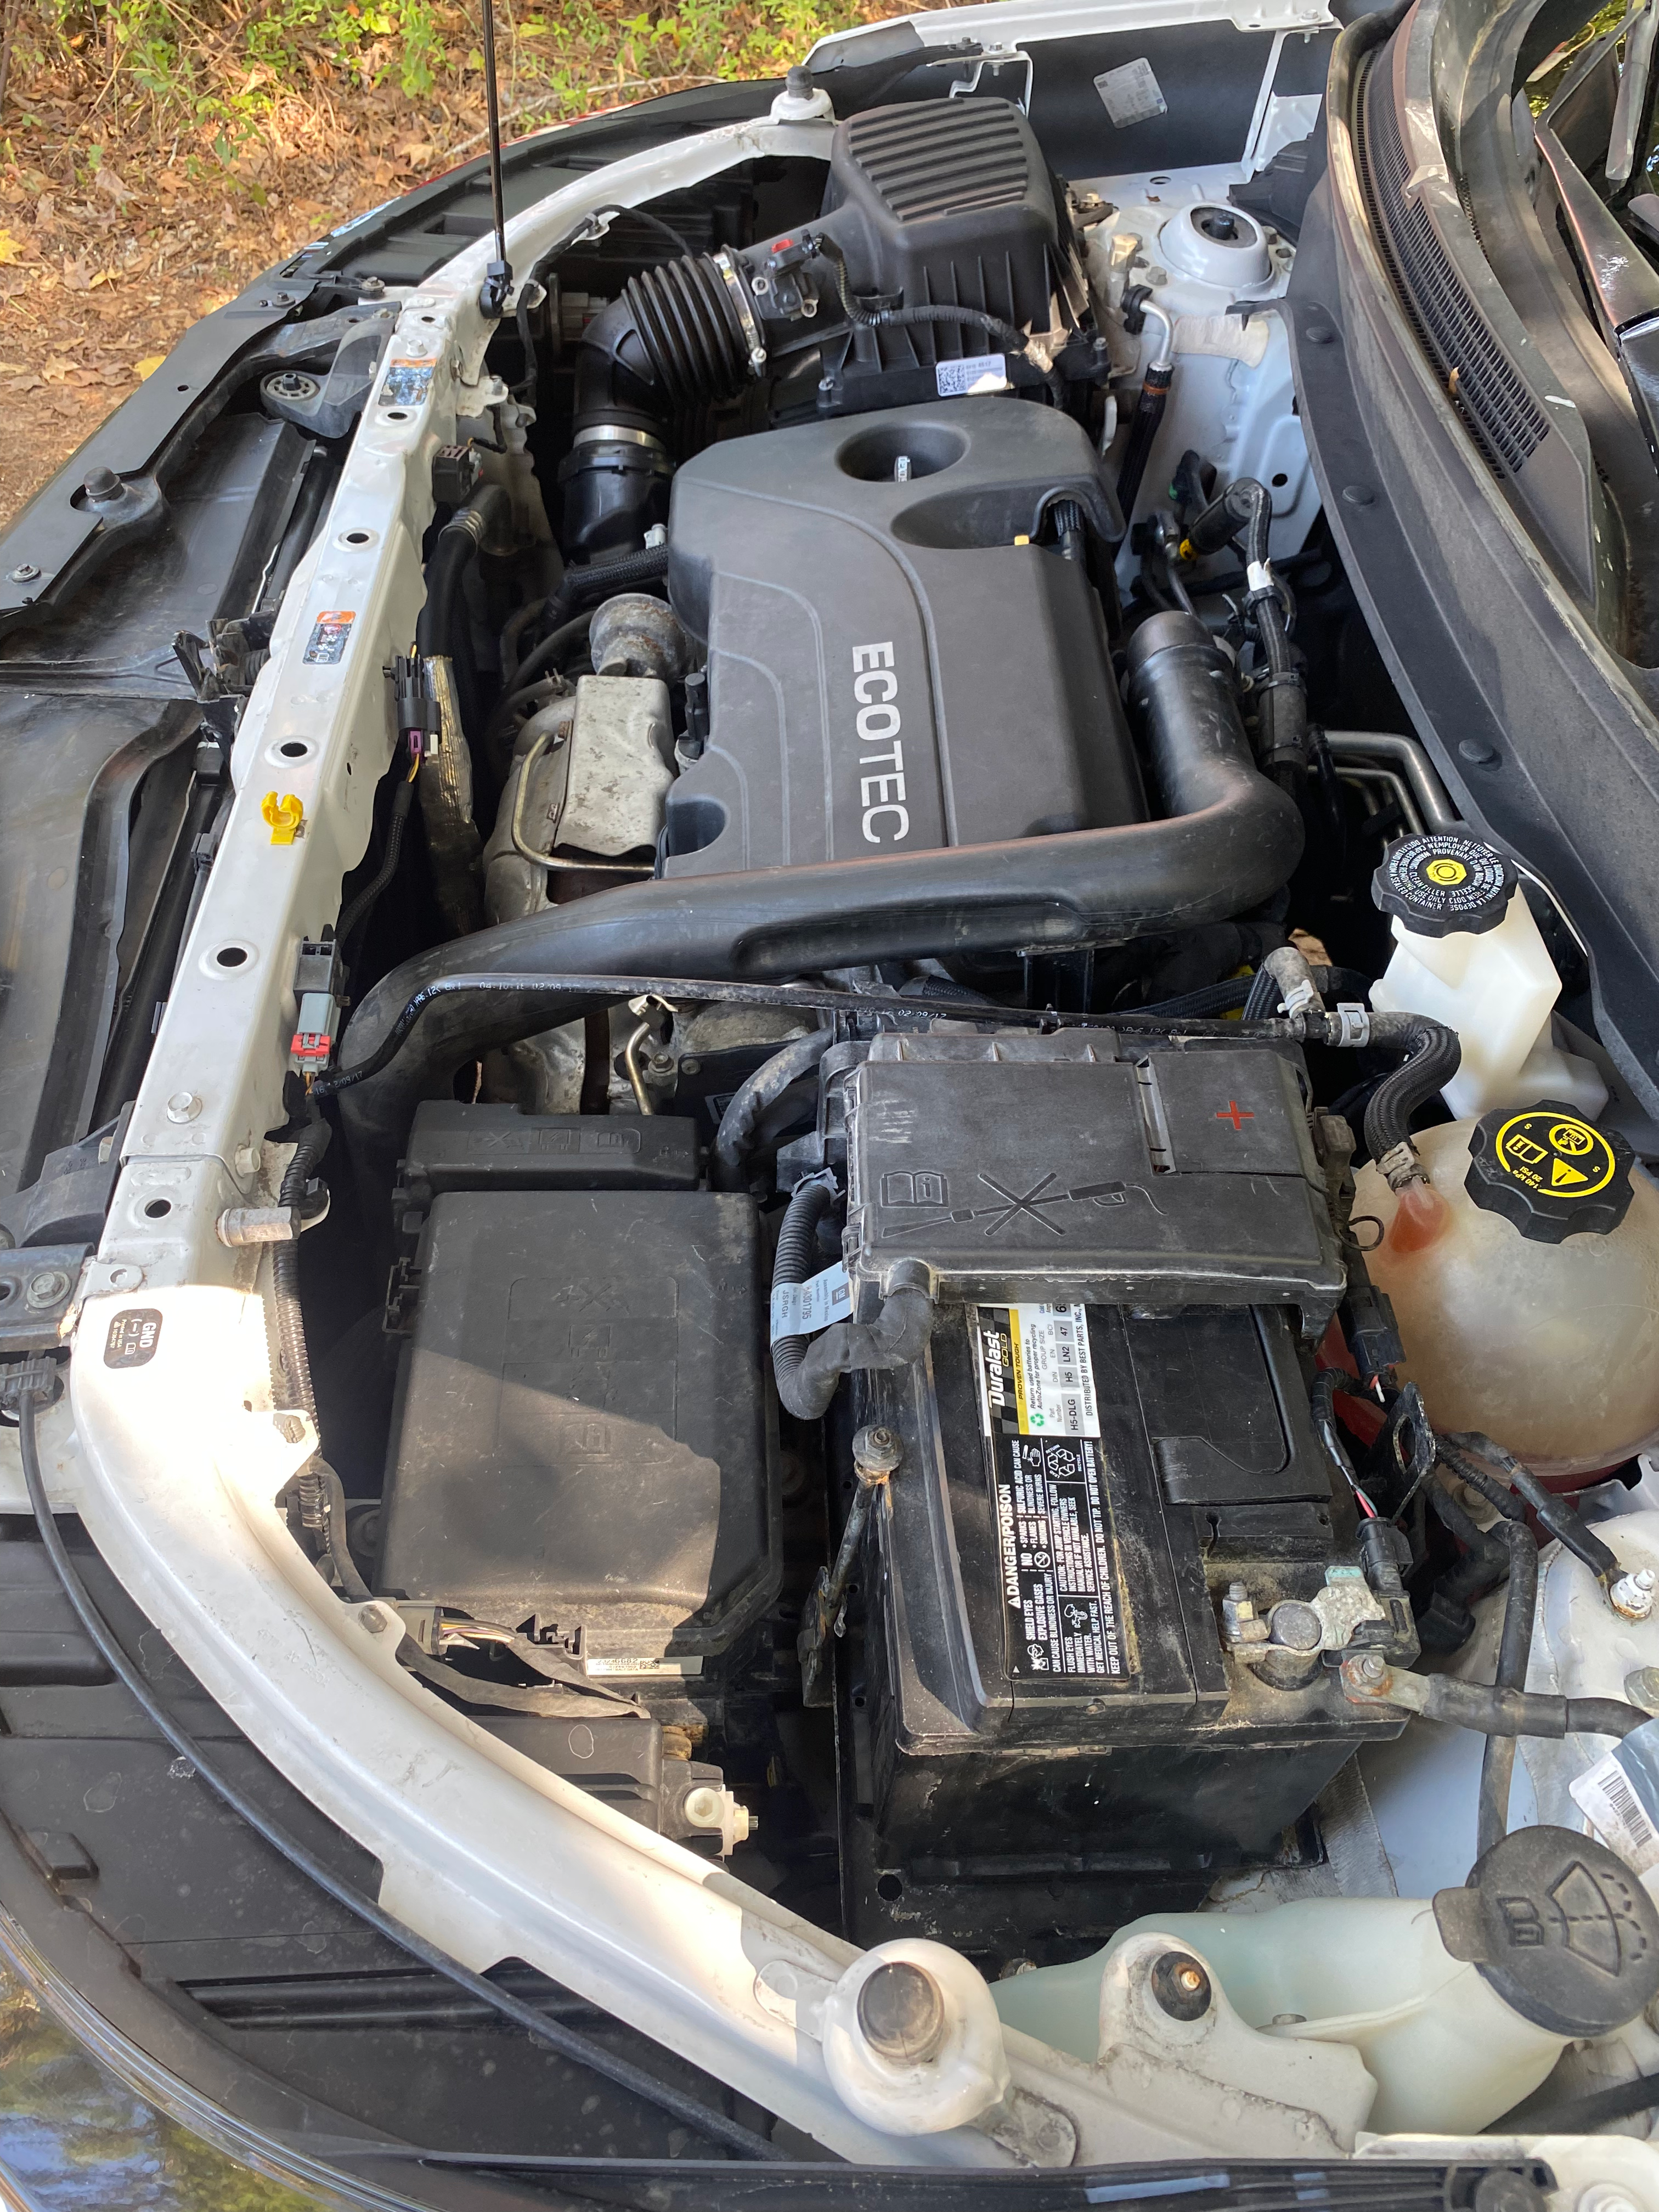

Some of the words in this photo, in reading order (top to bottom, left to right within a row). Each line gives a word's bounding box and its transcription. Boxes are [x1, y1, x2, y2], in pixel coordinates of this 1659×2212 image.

[853, 641, 909, 843] ECOTEC
[1393, 848, 1408, 860] FLUID
[1415, 845, 1426, 854] CAP
[1432, 849, 1473, 861] PROVENANT
[1463, 839, 1493, 858] NETTOYER
[1389, 860, 1399, 872] FROM
[1400, 850, 1417, 867] BEFORE
[1427, 842, 1469, 852] N'EMPLOYER
[1469, 850, 1482, 859] QUE
[1483, 866, 1493, 883] LIQUIDE
[1399, 867, 1416, 890] REMOVING
[1409, 872, 1423, 887] CLEAN
[1421, 885, 1445, 896] FILLER
[1493, 864, 1504, 887] BOUCHON
[1391, 877, 1408, 894] SEALED
[1452, 885, 1475, 897] SCELLE
[1485, 886, 1500, 900] AVANT
[1405, 893, 1442, 910] CONTAINER
[1414, 890, 1428, 899] USE
[1428, 895, 1446, 903] ONLY
[1450, 902, 1477, 911] DEPOSE
[1513, 1169, 1527, 1181] kPa
[1519, 1166, 1533, 1176] PSI
[1531, 1174, 1543, 1182] 20
[1525, 1178, 1538, 1189] 140
[838, 1289, 845, 1299] GM
[139, 1323, 156, 1347] GND
[1060, 1327, 1068, 1336] 47
[1001, 1333, 1009, 1367] GOLD
[1050, 1349, 1056, 1358] EN
[1062, 1346, 1070, 1362] LN2
[983, 1330, 1005, 1408] Duralast
[1065, 1372, 1073, 1382] H5
[1082, 1376, 1093, 1415] DISTRIBUTED
[1068, 1399, 1079, 1430] H5-DLG
[1012, 1440, 1020, 1457] CAUSE
[1084, 1441, 1094, 1466] BATTERY!
[1014, 1470, 1023, 1484] ACID
[1035, 1474, 1043, 1492] BURNS
[1087, 1468, 1097, 1483] OPEN
[1026, 1484, 1035, 1514] BLINDNESS
[1049, 1485, 1058, 1505] FOLLOW
[1090, 1485, 1098, 1496] NOT
[1016, 1486, 1026, 1513] SULFURIC
[1036, 1494, 1045, 1514] SEVERE
[1068, 1497, 1076, 1510] SEEK
[1059, 1498, 1069, 1521] OWNERS
[1093, 1507, 1102, 1518] TIP.
[1051, 1506, 1062, 1534] STARTING,
[1069, 1511, 1080, 1541] AVAILABLE,
[1094, 1520, 1103, 1532] NOT
[998, 1485, 1019, 1595] DANGER/POISON
[1019, 1521, 1028, 1543] SPARKS
[1029, 1522, 1037, 1543] FLAMES
[1039, 1520, 1048, 1544] SMOKING
[1062, 1522, 1071, 1543] VEHICLE
[1096, 1534, 1104, 1543] DO
[1054, 1535, 1063, 1550] JUMP
[1072, 1542, 1081, 1553] NOT
[1082, 1533, 1092, 1567] ASSISTANCE.
[1021, 1553, 1032, 1566] NO
[1056, 1551, 1064, 1562] FOR
[1074, 1560, 1083, 1568] OR
[1097, 1546, 1109, 1580] CHILDREN.
[1058, 1565, 1068, 1592] CAUTION:
[1066, 1552, 1076, 1592] INSTRUCTIONS
[1075, 1569, 1085, 1592] MANUAL
[1085, 1569, 1095, 1592] SERVICE
[1044, 1573, 1053, 1594] INJURY
[1101, 1581, 1110, 1590] OF
[1033, 1584, 1044, 1604] GASES
[1023, 1600, 1034, 1616] EYES
[1089, 1601, 1098, 1617] FAST.
[1102, 1592, 1113, 1614] REACH
[1025, 1617, 1036, 1640] SHIELD
[1036, 1606, 1048, 1640] EXPLOSIVE
[1047, 1605, 1058, 1638] BLINDNESS
[1091, 1618, 1101, 1633] HELP
[1105, 1615, 1115, 1628] THE
[1106, 1630, 1116, 1639] OF
[1051, 1639, 1059, 1658] CAUSE
[1065, 1637, 1073, 1651] EYES
[1074, 1632, 1086, 1673] IMMEDIATELY
[1084, 1633, 1093, 1656] WATER.
[1093, 1634, 1103, 1660] MEDICAL
[1108, 1641, 1118, 1655] OUT
[1052, 1660, 1061, 1672] CAN
[1066, 1654, 1076, 1672] FLUSH
[1085, 1657, 1095, 1673] WITH
[1096, 1662, 1105, 1673] GET
[1109, 1657, 1120, 1674] KEEP
